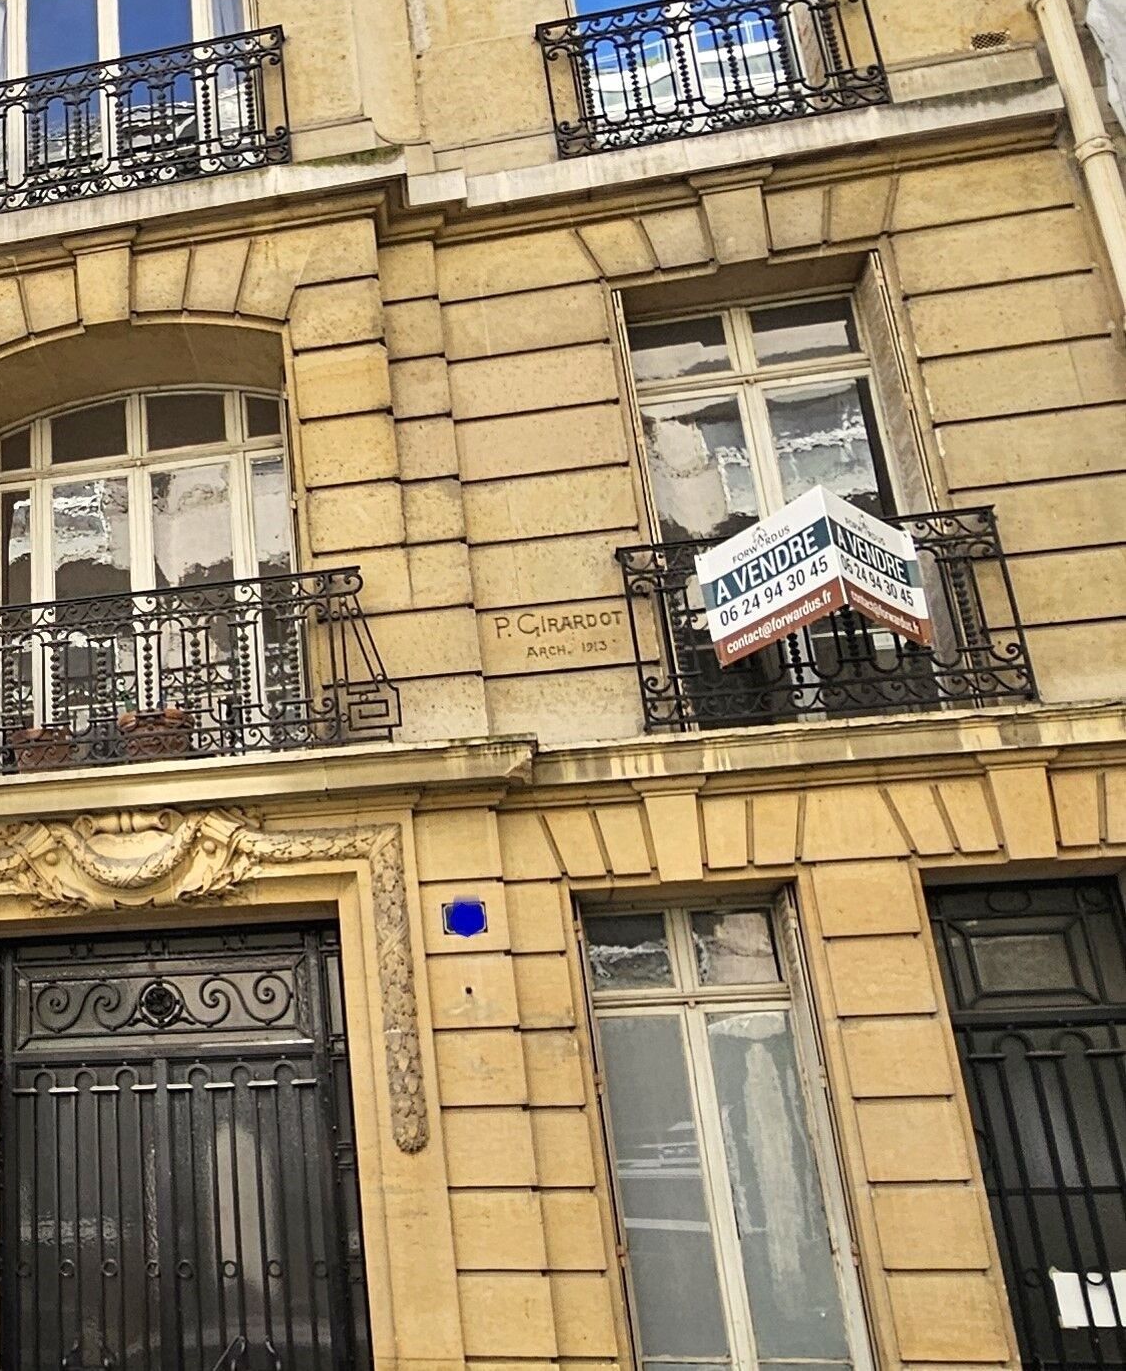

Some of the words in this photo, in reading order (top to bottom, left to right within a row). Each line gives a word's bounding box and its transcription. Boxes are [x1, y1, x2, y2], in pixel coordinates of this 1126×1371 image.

[717, 579, 732, 605] A
[732, 527, 818, 593] VENDRE
[837, 525, 848, 551] A
[846, 530, 907, 583] VENDRE
[840, 554, 853, 574] 06
[854, 562, 868, 584] 24
[869, 571, 882, 591] 94
[883, 579, 898, 599] 30
[900, 588, 914, 607] 45
[720, 605, 738, 627] 06
[742, 593, 760, 616] 24
[764, 581, 783, 603] 94
[786, 569, 805, 591] 30
[810, 555, 828, 577] 45
[726, 589, 832, 654] contact@forwardus.fr
[517, 611, 623, 637] GIRARDOT
